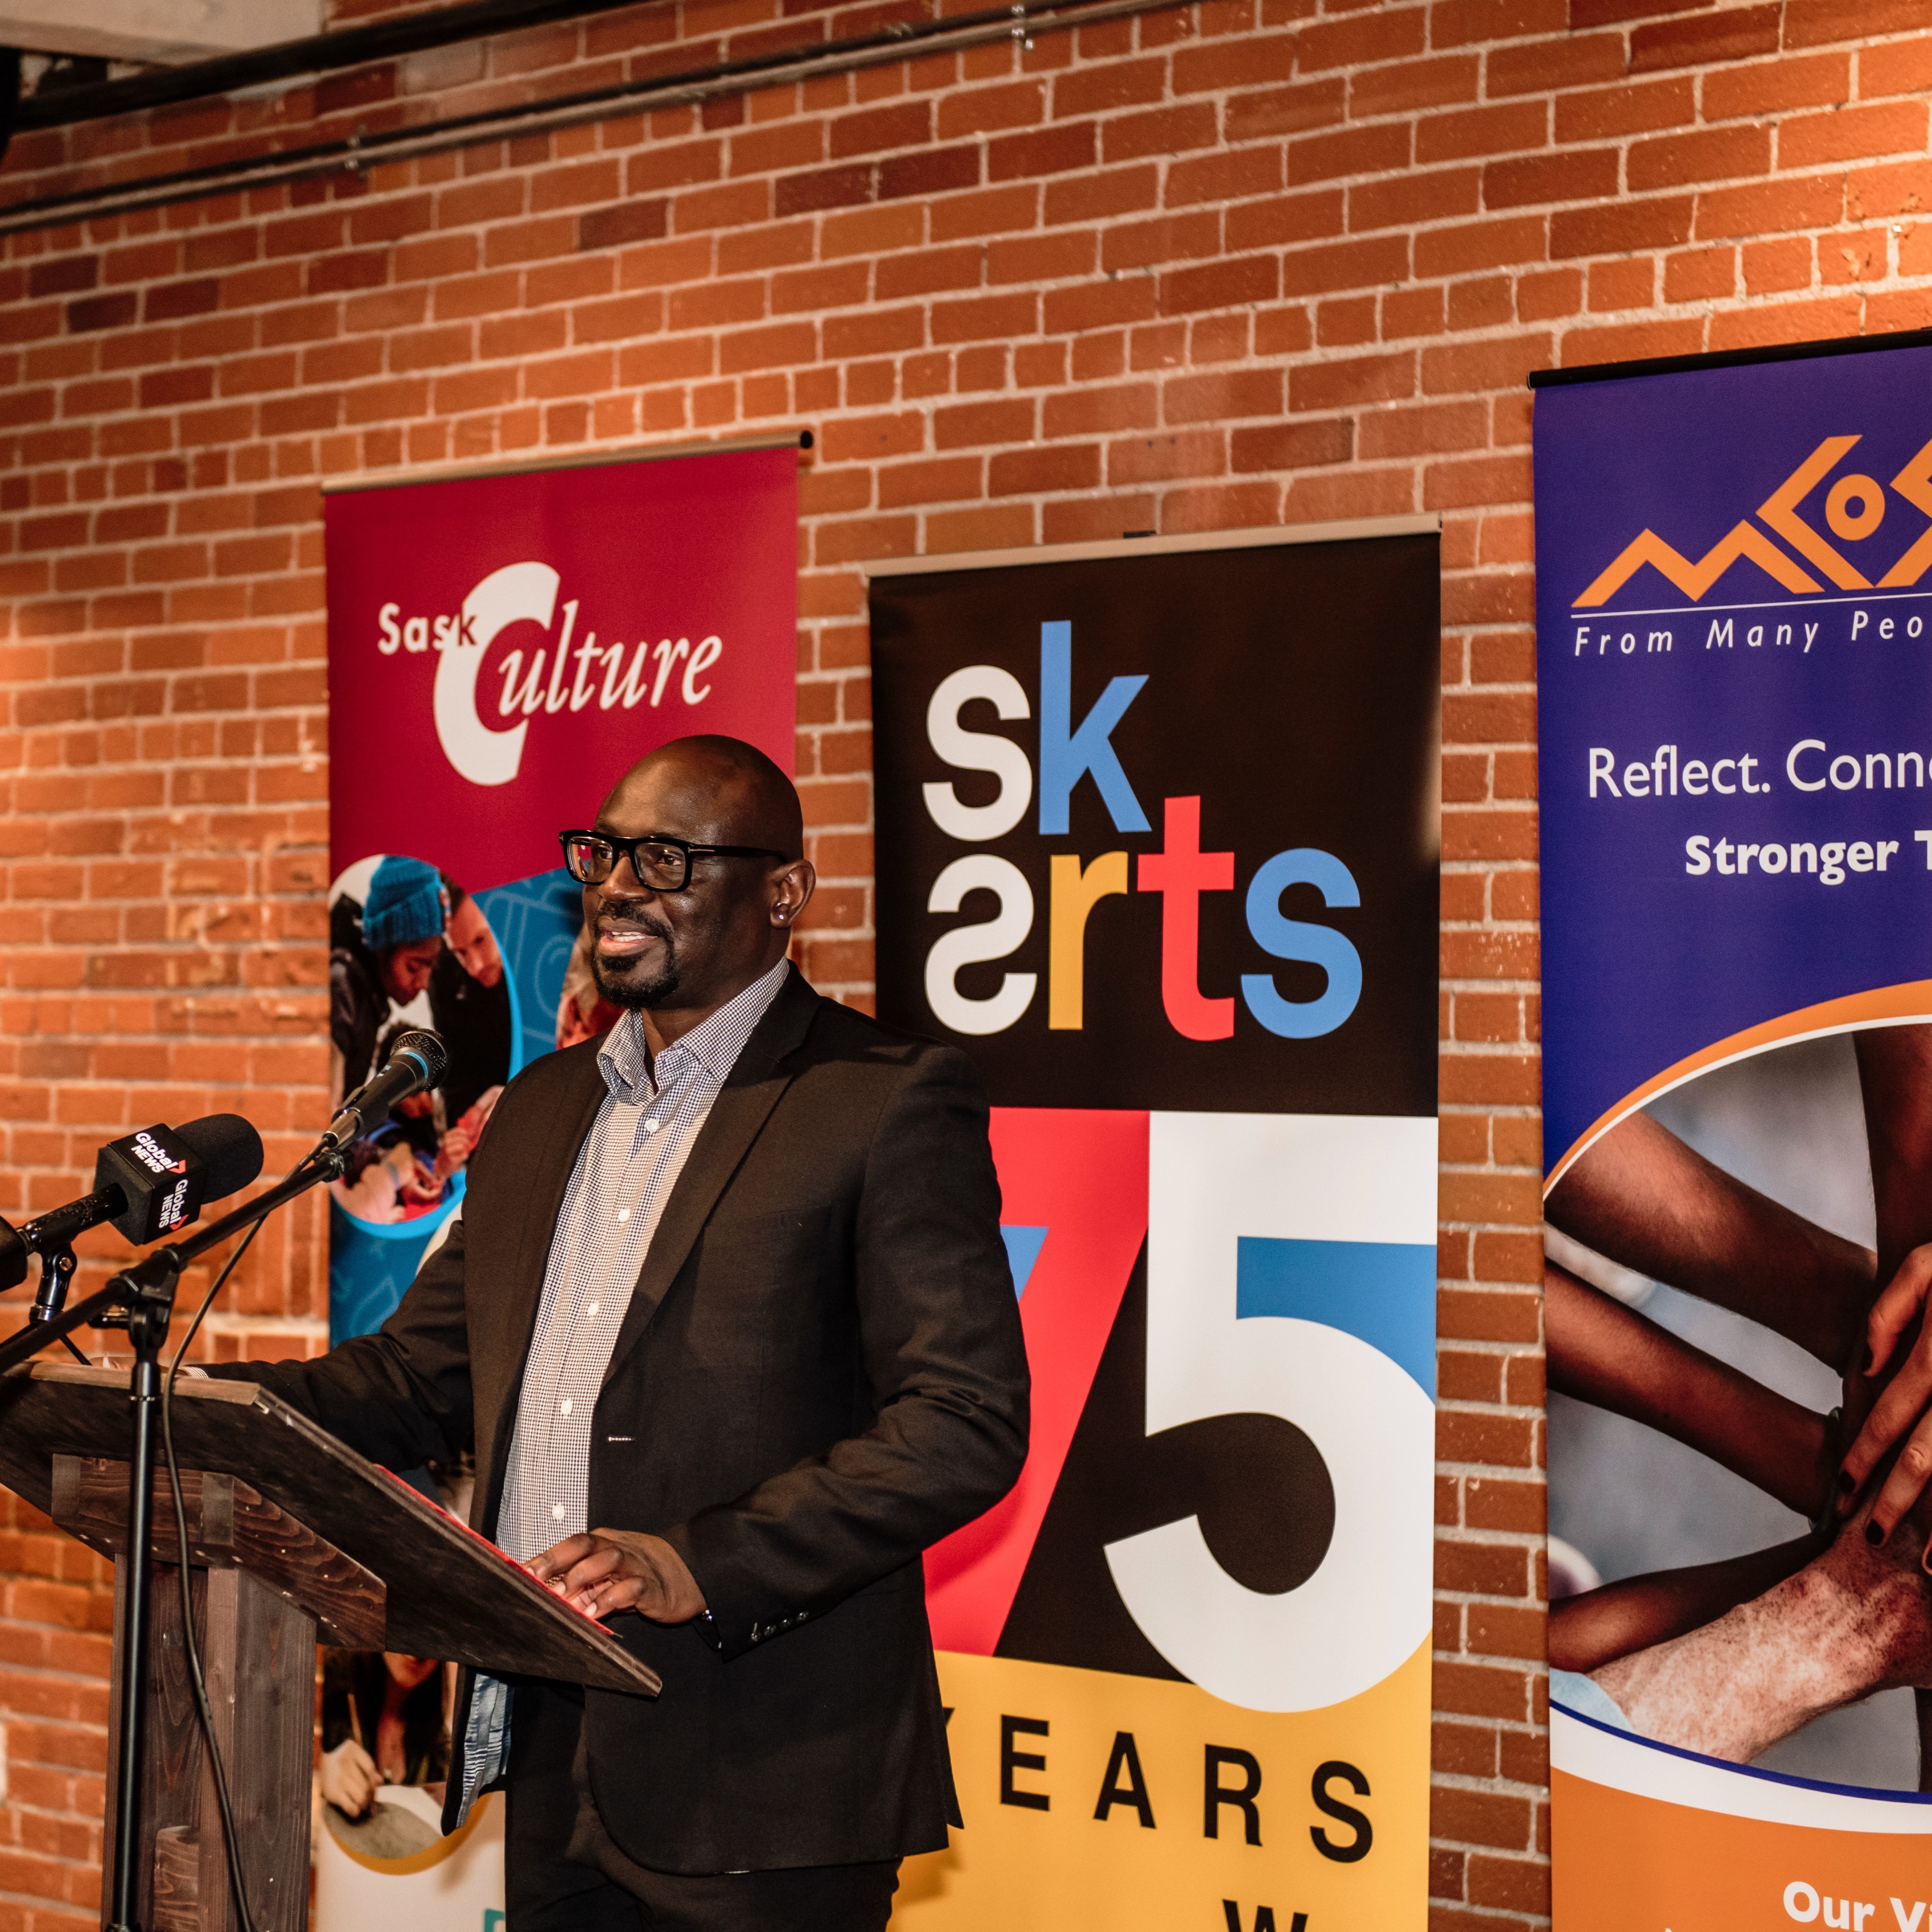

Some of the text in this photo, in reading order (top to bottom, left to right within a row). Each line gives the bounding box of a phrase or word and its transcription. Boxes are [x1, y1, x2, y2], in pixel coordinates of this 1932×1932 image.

[1575, 626, 1674, 657] From
[1706, 618, 1820, 653] Many
[922, 620, 1152, 841] sk
[1589, 739, 1932, 799] Reflect. Conn
[1685, 835, 1900, 886] Stronger
[130, 1145, 165, 1173] NEWS
[135, 1133, 179, 1169] Global
[158, 1194, 174, 1228] NEWS
[170, 1179, 188, 1224] Global
[943, 1707, 1374, 1863] EARS
[1783, 1881, 1876, 1932] Our
